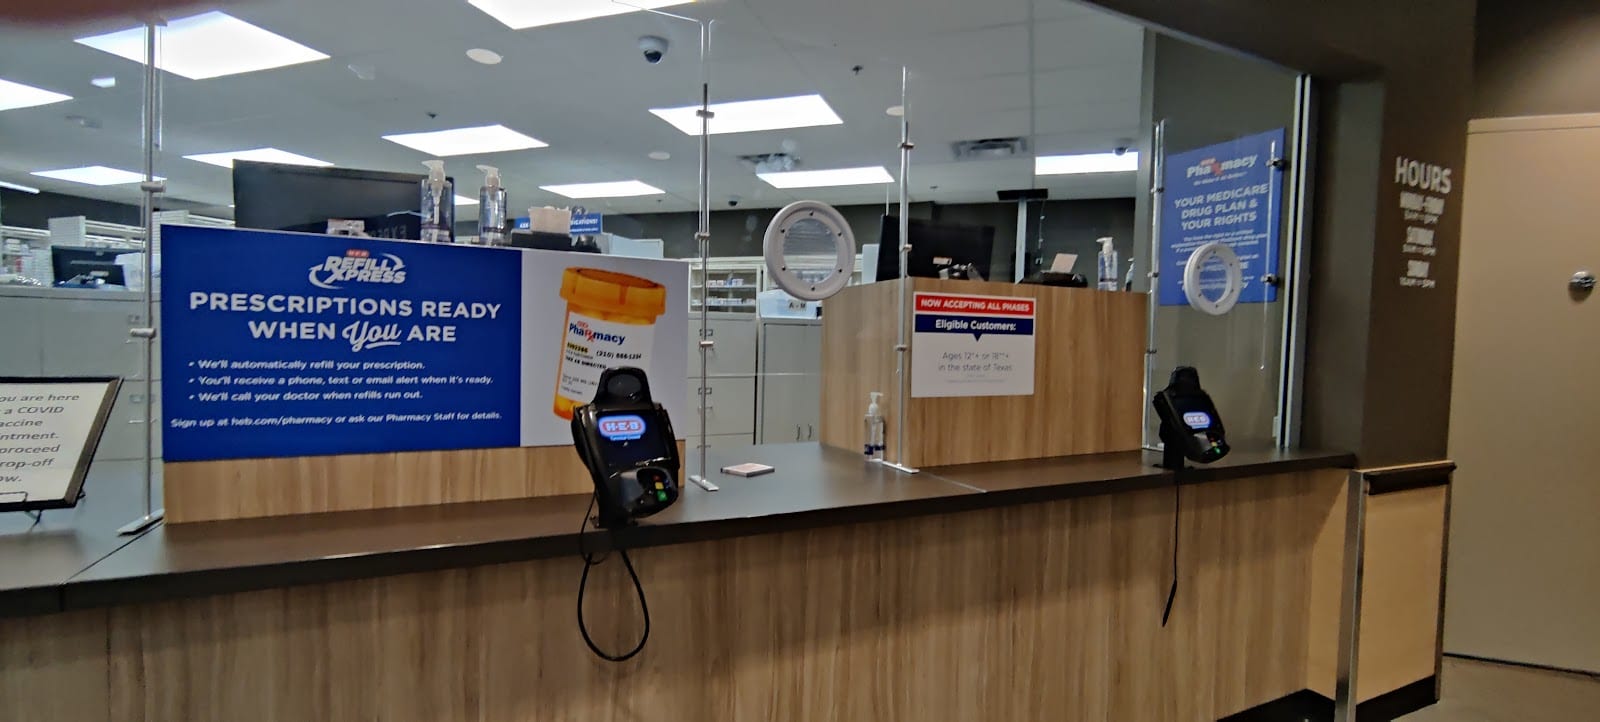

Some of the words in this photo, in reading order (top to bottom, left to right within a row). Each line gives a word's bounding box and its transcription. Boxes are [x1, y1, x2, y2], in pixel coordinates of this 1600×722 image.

[1395, 155, 1452, 194] HOURS
[1174, 195, 1205, 208] YOUR
[1206, 183, 1269, 204] MEDICARE
[1181, 206, 1213, 219] DRUG
[1215, 199, 1246, 213] PLAN
[1249, 198, 1259, 208] &
[1181, 219, 1211, 231] YOUR
[1213, 211, 1257, 226] RIGHTS
[325, 256, 388, 271] REFILL
[323, 268, 407, 284] XPRESS
[189, 291, 413, 317] PRESCRIPTIONS
[421, 301, 502, 320] READY
[921, 299, 941, 307] NOW
[943, 301, 985, 309] ACCEPTING
[1002, 303, 1030, 312] PHASES
[935, 319, 968, 330] Eligible
[970, 320, 1017, 330] Customers:
[248, 321, 336, 340] WHEN
[341, 320, 402, 353] You
[406, 325, 457, 342] ARE
[942, 352, 962, 361] Ages
[198, 360, 228, 369] We'll
[231, 360, 306, 370] automatically
[310, 360, 334, 369] refill
[336, 363, 360, 371] your
[363, 361, 425, 370] prescription.
[948, 363, 960, 371] the
[962, 363, 981, 371] state
[198, 376, 231, 386] You'll
[233, 377, 275, 385] receive
[288, 376, 326, 386] phone,
[328, 376, 349, 385] text
[366, 376, 393, 385] email
[395, 376, 418, 384] alert
[421, 376, 447, 384] when
[449, 376, 463, 384] it's
[465, 376, 494, 385] ready.
[198, 392, 228, 401] We'll
[231, 392, 251, 401] call
[254, 394, 280, 402] your
[283, 391, 320, 401] doctor
[323, 391, 351, 400] when
[354, 391, 382, 399] refills
[403, 391, 423, 399] out.
[17, 406, 65, 414] COVID
[0, 419, 43, 428] accine
[170, 418, 196, 429] Sign
[200, 419, 214, 428] up
[231, 416, 332, 427] heb.com/pharmacy
[348, 414, 365, 423] ask
[385, 413, 431, 422] Pharmacy
[433, 412, 454, 420] Staff
[456, 411, 469, 420] for
[471, 411, 502, 420] details.
[0, 432, 59, 440] ntment.
[0, 458, 55, 469] rop-off
